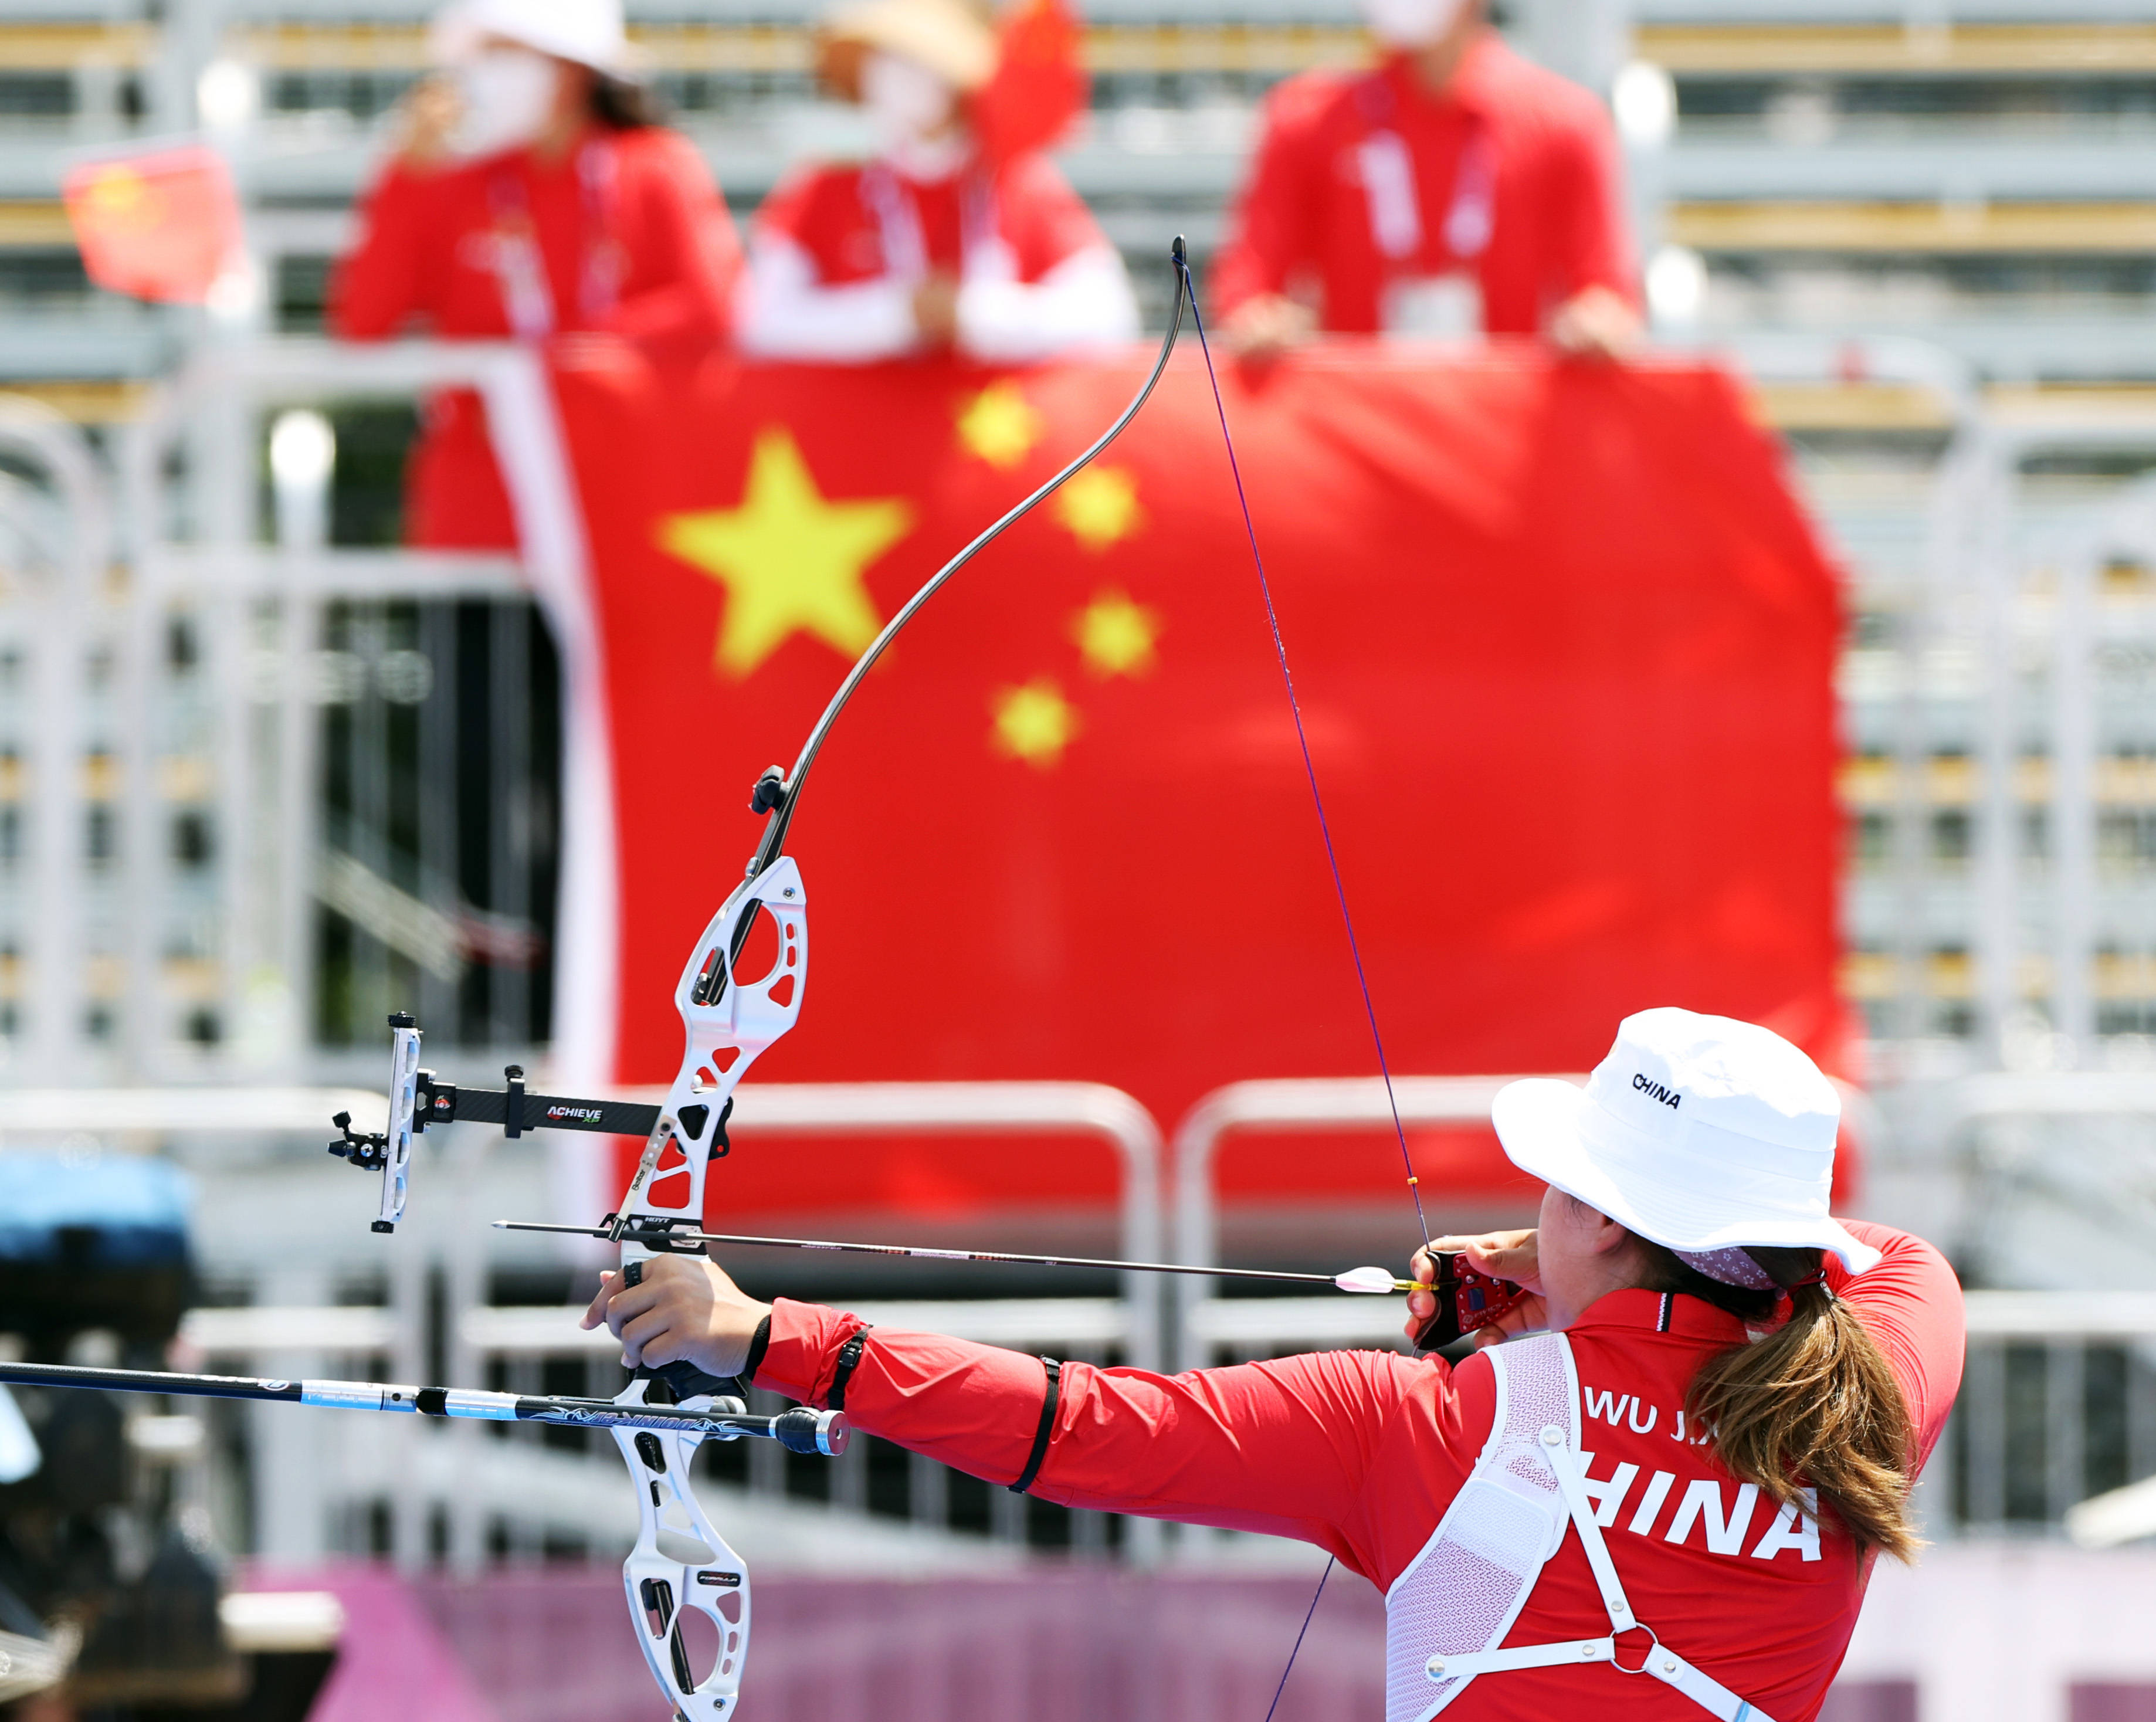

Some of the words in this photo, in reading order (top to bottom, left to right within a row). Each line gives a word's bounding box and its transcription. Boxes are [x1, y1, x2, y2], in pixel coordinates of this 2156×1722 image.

[547, 1106, 603, 1118] ACHIEVE
[1633, 1073, 1682, 1110] CHINA
[1584, 1386, 1658, 1434] WU
[1579, 1450, 1822, 1562] HINA
